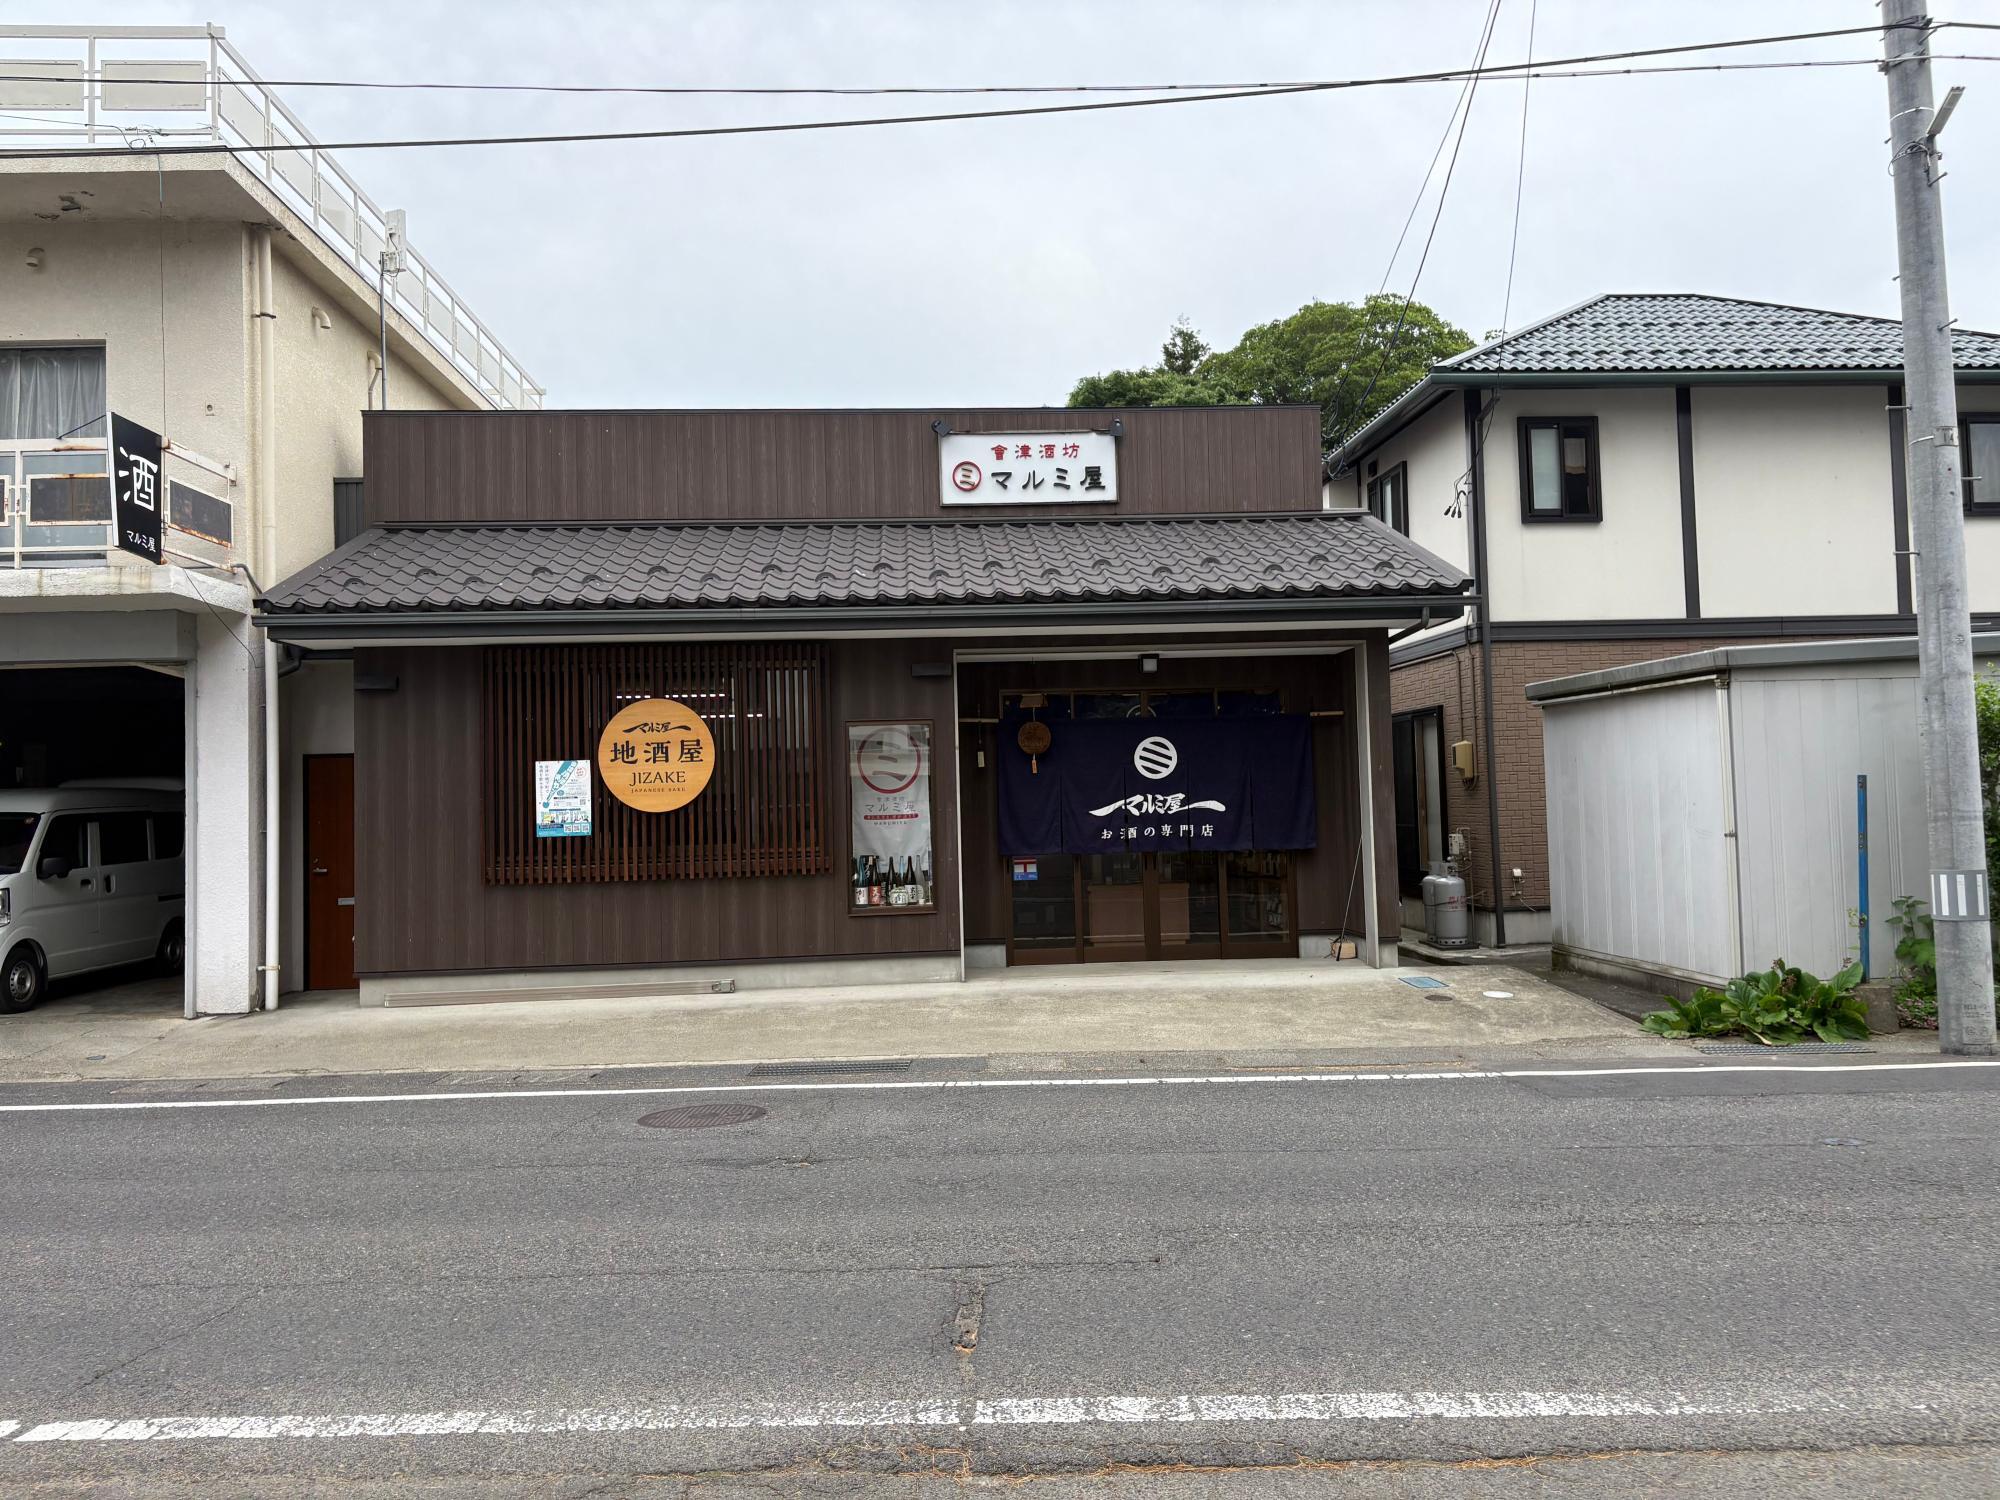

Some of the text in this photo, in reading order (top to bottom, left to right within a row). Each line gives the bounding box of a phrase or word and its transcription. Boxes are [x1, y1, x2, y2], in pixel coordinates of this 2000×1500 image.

[118, 446, 159, 512] 酒
[991, 466, 1106, 491] マルミ屋
[126, 530, 156, 553] マルミ屋
[622, 721, 692, 734] マルミ屋
[610, 738, 703, 764] 地酒屋
[629, 771, 686, 787] JIZAKE
[1088, 792, 1227, 817] マルミ屋
[1101, 823, 1214, 840] お酒の専門店
